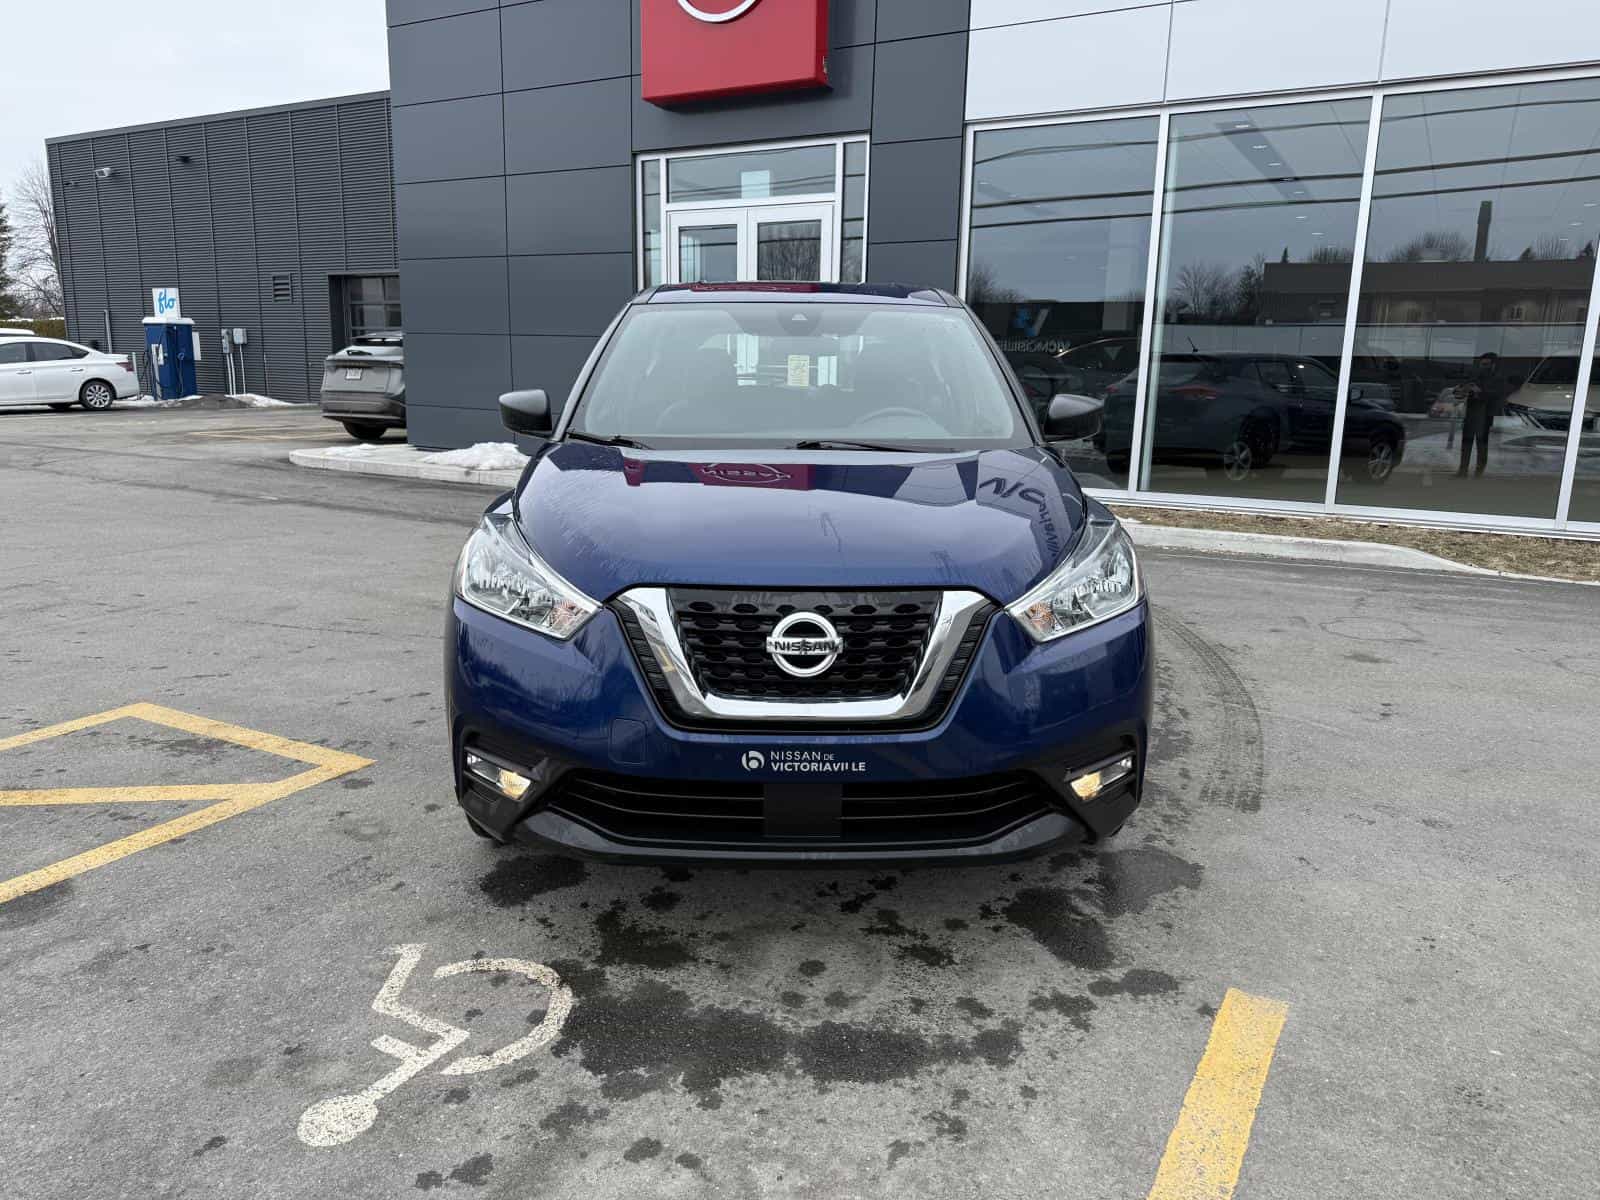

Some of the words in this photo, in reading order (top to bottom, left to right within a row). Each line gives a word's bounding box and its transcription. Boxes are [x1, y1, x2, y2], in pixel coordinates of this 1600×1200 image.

[158, 288, 176, 314] flo
[773, 641, 836, 652] NISSAN
[770, 751, 821, 761] NISSAN
